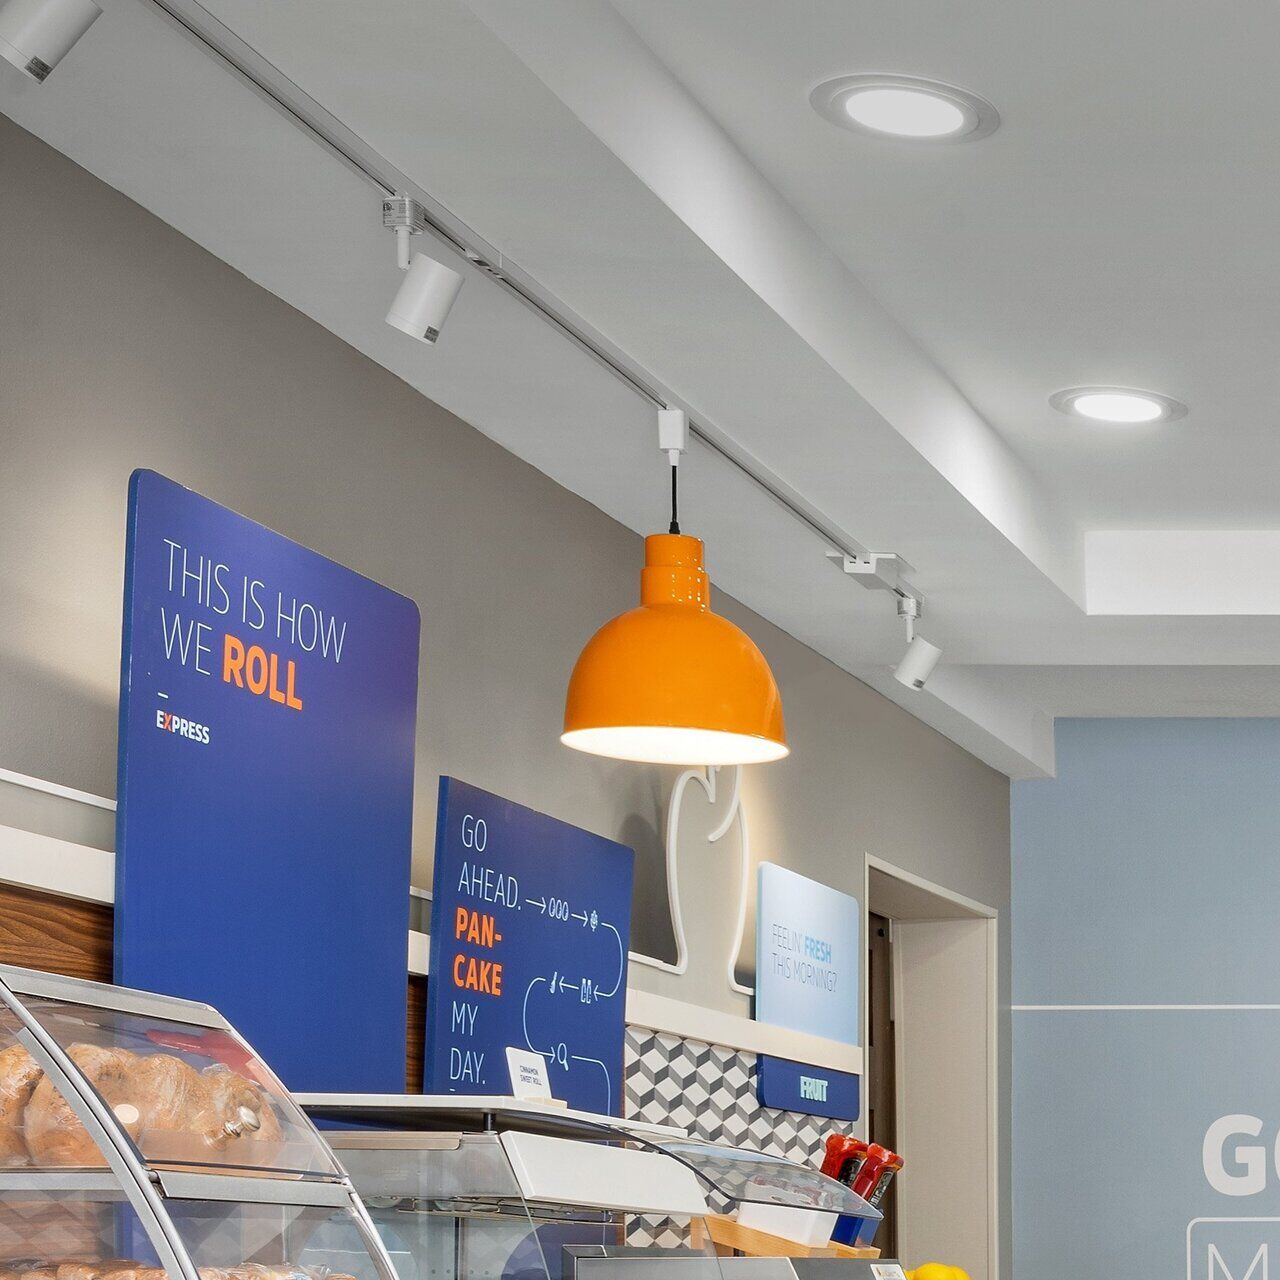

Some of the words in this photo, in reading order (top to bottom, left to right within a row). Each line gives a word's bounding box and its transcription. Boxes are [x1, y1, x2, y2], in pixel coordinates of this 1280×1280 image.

[163, 538, 230, 615] THIS
[242, 576, 266, 630] IS
[276, 592, 347, 663] HOW
[161, 607, 212, 676] WE
[223, 633, 303, 711] ROLL
[156, 709, 211, 744] EXPRESS
[462, 814, 488, 852] GO
[458, 862, 521, 911] AHEAD.
[455, 907, 502, 948] PAN-
[804, 936, 832, 964] FRESH
[453, 954, 502, 997] CAKE
[772, 953, 791, 980] THIS
[794, 962, 838, 993] MORNING?
[452, 1000, 479, 1036] MY
[450, 1048, 486, 1085] DAY.
[800, 1076, 828, 1102] FRUIT
